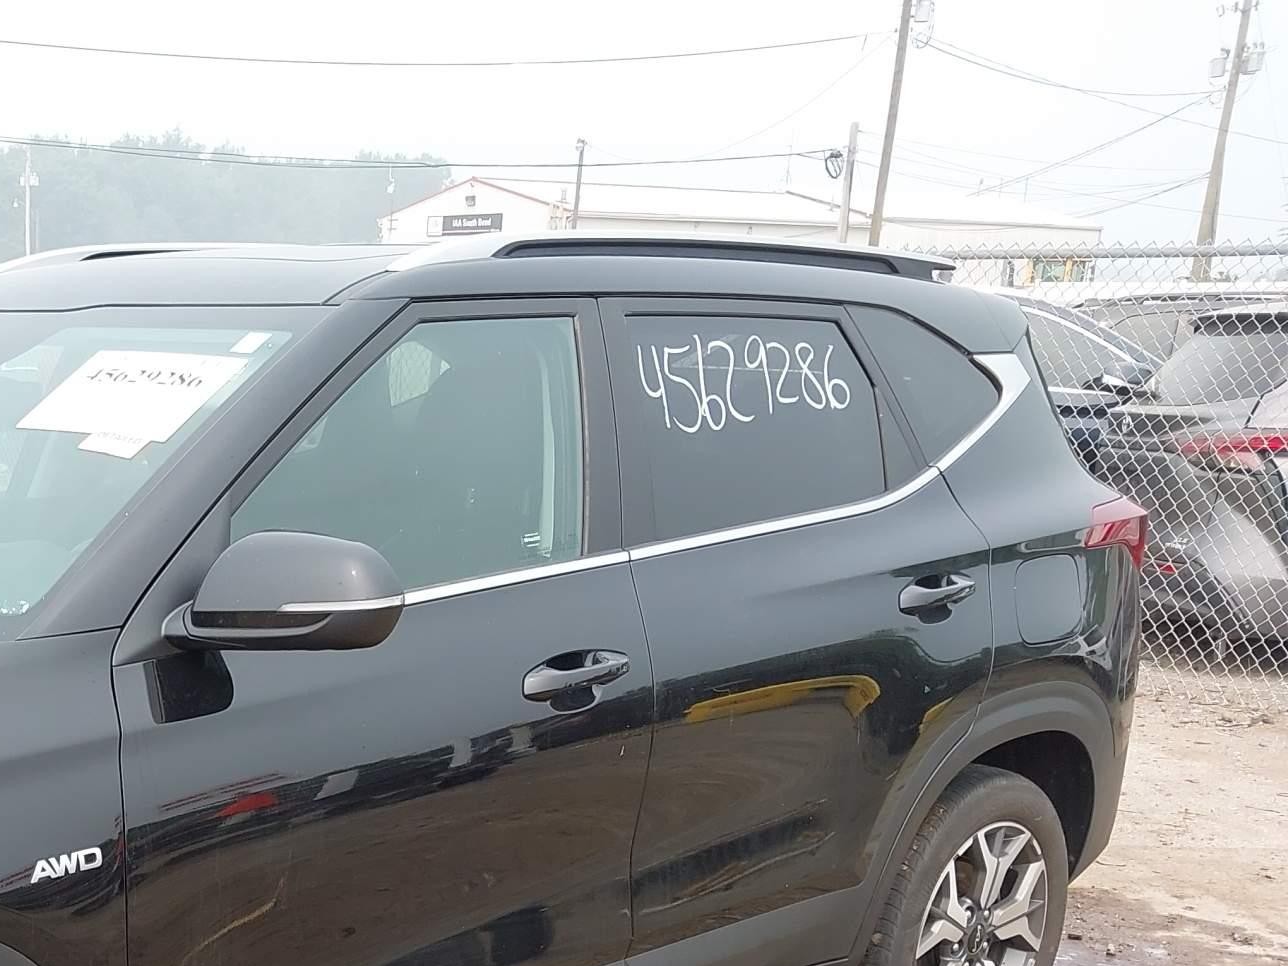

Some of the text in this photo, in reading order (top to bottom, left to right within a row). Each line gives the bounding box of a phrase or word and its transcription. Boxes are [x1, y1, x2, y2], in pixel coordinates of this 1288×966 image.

[86, 367, 204, 389] 45629286
[637, 334, 851, 433] 45629286
[30, 847, 103, 884] AWD
